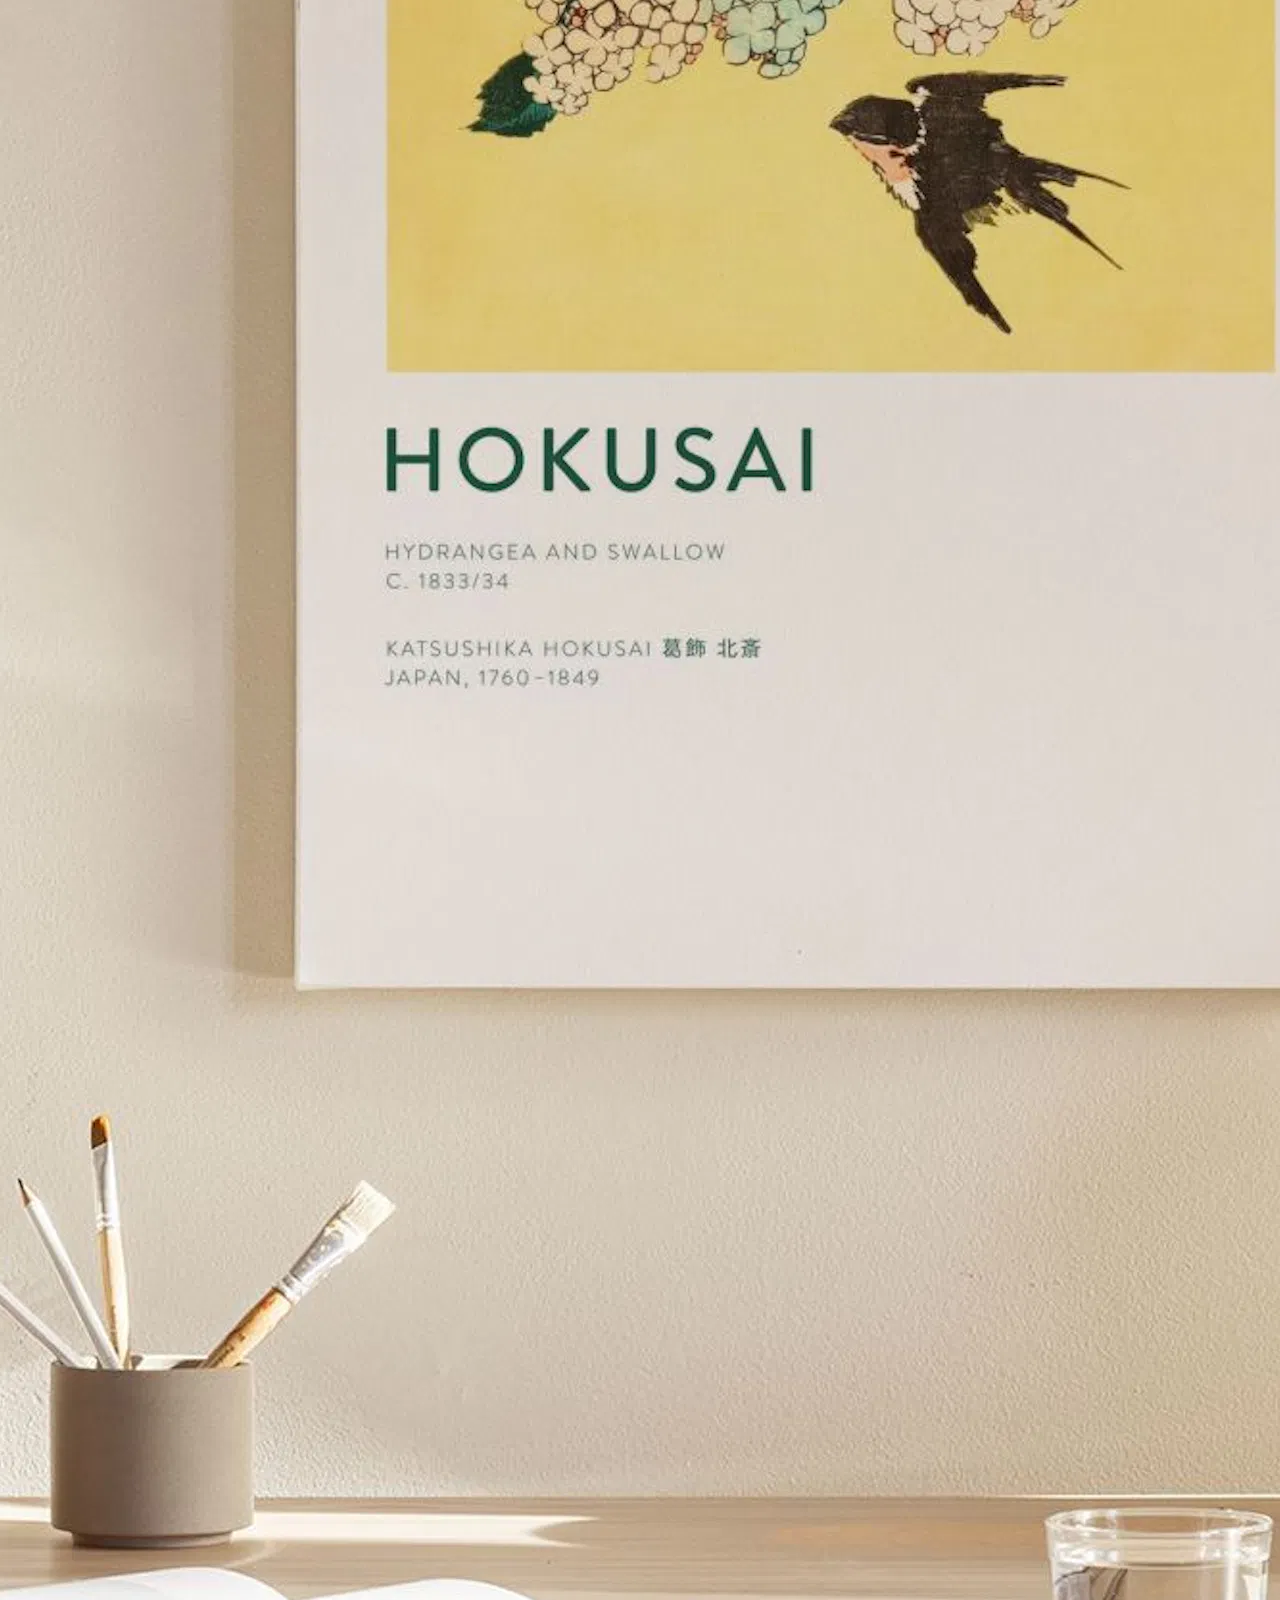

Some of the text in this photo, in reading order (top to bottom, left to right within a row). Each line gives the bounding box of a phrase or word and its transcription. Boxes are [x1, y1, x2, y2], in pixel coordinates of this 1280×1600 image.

[385, 426, 813, 493] HOKUSAI
[384, 542, 725, 561] HYDRANGEA AND SWALLOW
[385, 571, 509, 590] C. 1833/34
[385, 640, 534, 659] KATSUSHIKA
[543, 640, 651, 659] HOKUSAI
[383, 668, 470, 689] JAPAN,
